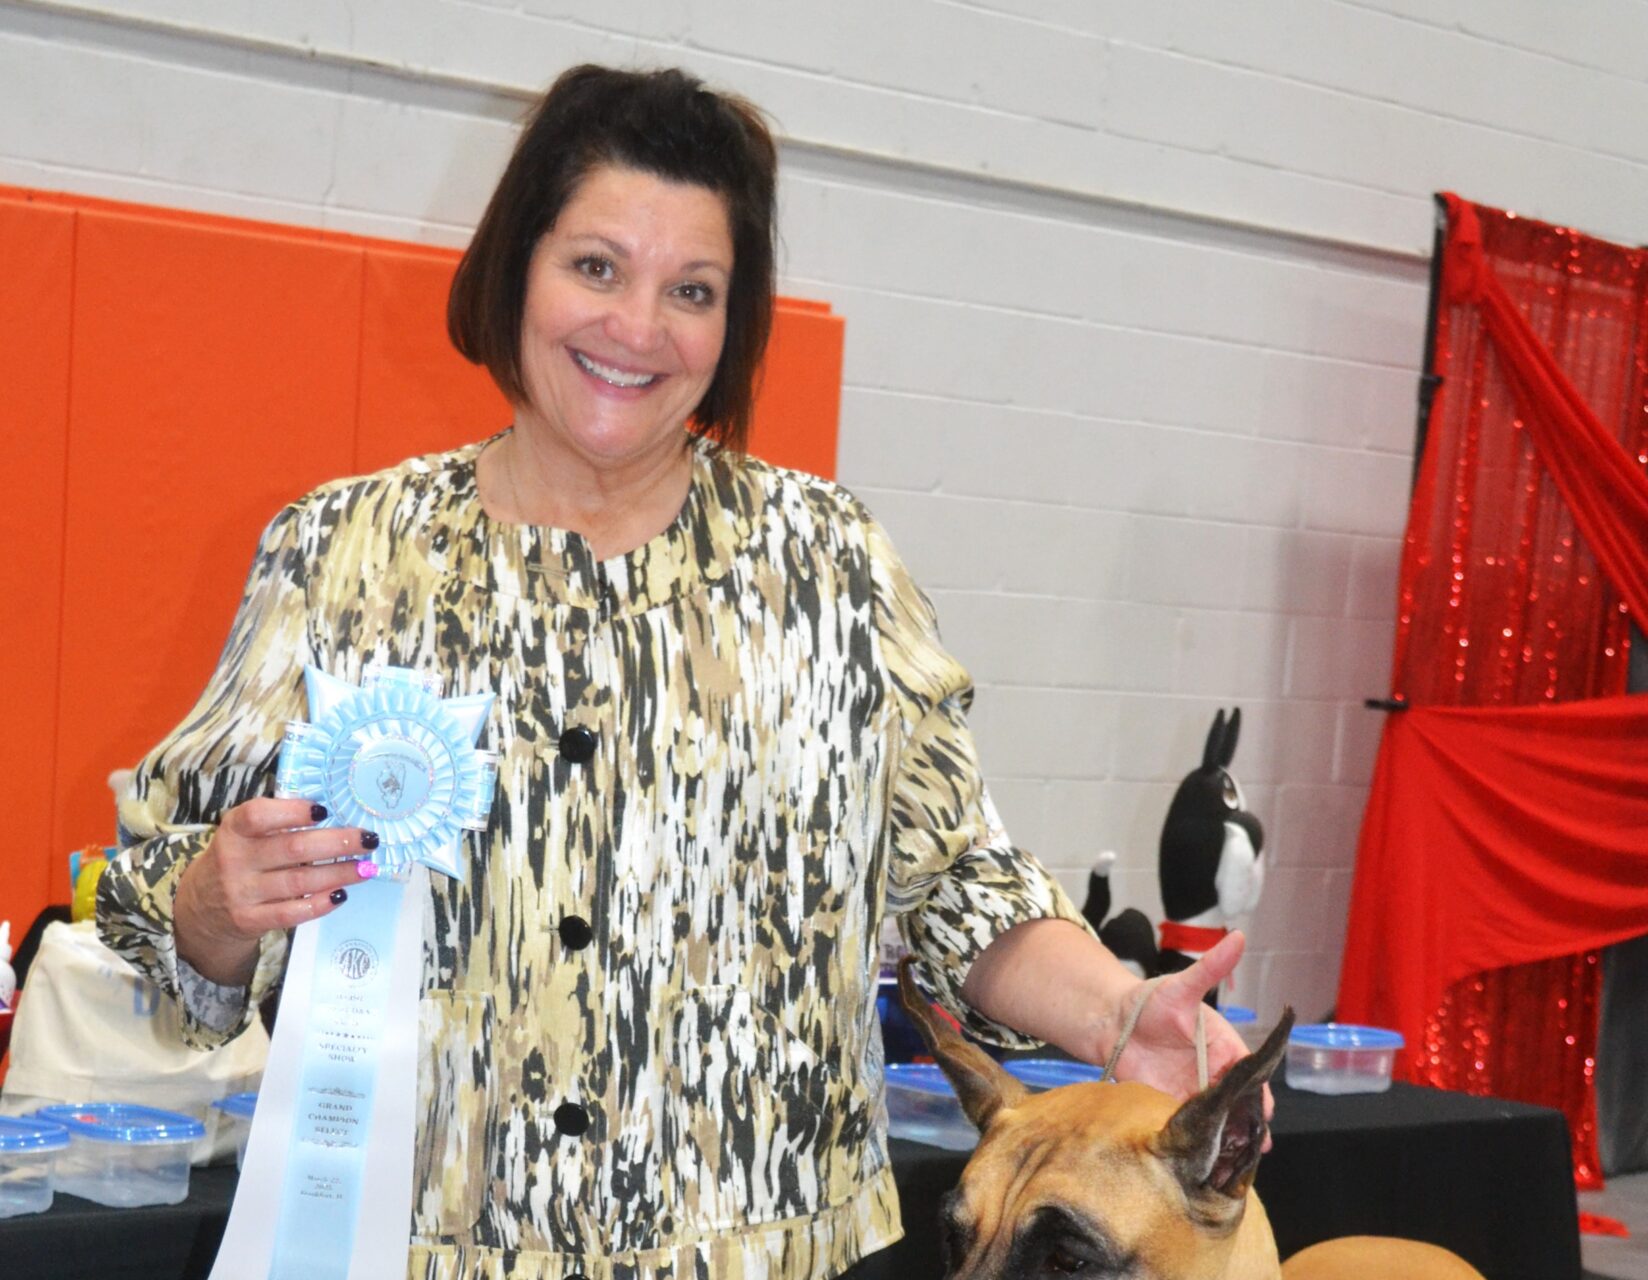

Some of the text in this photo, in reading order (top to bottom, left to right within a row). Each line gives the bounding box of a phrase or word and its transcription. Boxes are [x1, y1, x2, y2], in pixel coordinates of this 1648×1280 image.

[339, 947, 370, 979] AKC
[318, 1042, 367, 1054] SPECIALTY
[328, 1054, 355, 1063] SHOW
[318, 1103, 353, 1112] GRAND
[308, 1113, 359, 1125] CHAMPION
[315, 1127, 348, 1135] SELECT
